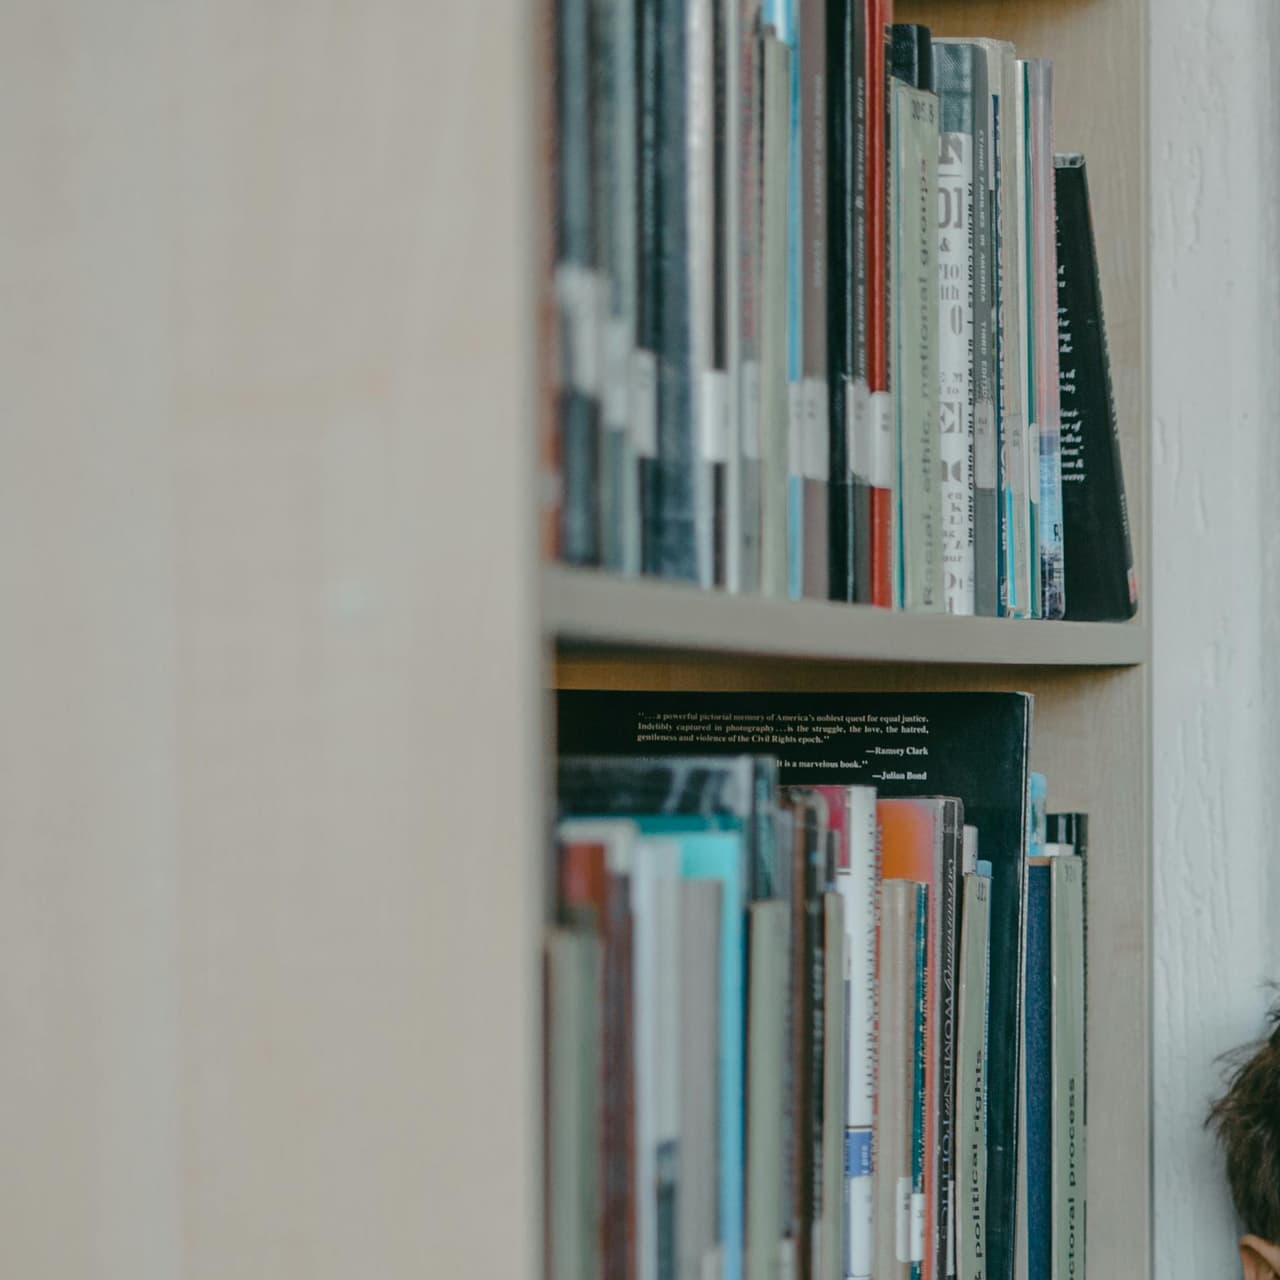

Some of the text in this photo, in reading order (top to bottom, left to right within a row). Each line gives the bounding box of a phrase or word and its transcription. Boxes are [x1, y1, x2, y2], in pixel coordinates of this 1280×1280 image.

[917, 157, 936, 607] Racial, national groups
[665, 712, 929, 725] powerful pictorial memory of America's noblest quest for equal justice.
[638, 722, 929, 736] Indelibly captured in the struggle, the love, the hatred,
[637, 733, 678, 744] gentleness
[678, 733, 694, 743] and
[696, 733, 726, 743] violence
[728, 733, 737, 743] of
[737, 734, 750, 743] the
[751, 734, 770, 743] Civil
[771, 734, 797, 745] Rights
[905, 746, 929, 756] Clark
[784, 760, 791, 769] is
[798, 760, 839, 770] marvelous
[907, 771, 928, 781] Bond
[969, 1048, 985, 1133] rights
[1065, 1076, 1080, 1187] process
[970, 1142, 987, 1259] political
